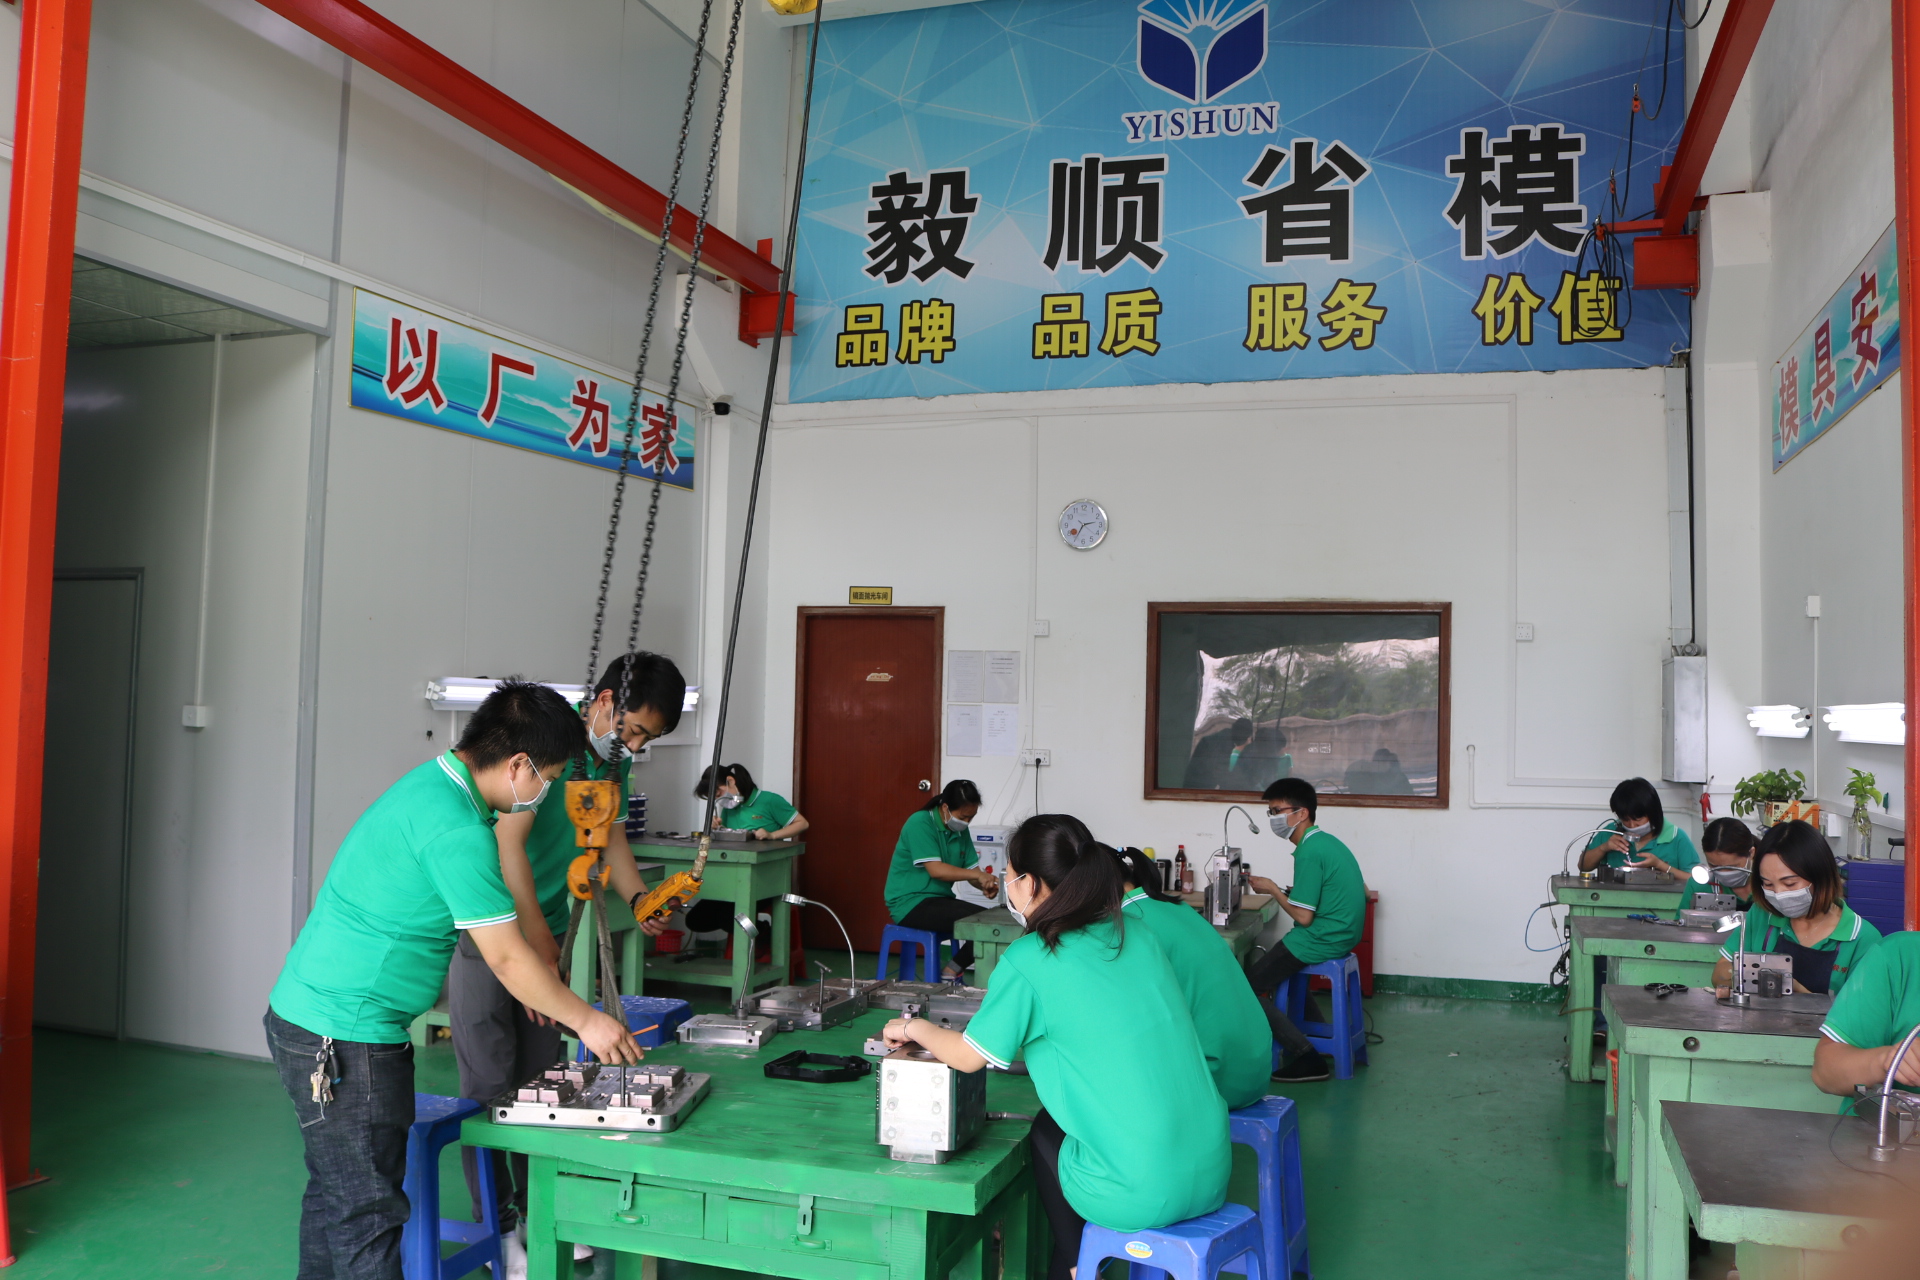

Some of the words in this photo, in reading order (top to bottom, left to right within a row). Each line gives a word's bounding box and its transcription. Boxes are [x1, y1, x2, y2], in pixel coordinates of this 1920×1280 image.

[1125, 105, 1276, 140] YISHUN
[864, 126, 1589, 284] 毅顺省模
[385, 316, 678, 471] 以厂为家
[836, 298, 955, 367] 品牌
[1032, 287, 1162, 359] 品质
[1243, 278, 1387, 351] 服务
[1472, 270, 1624, 345] 价值
[1778, 270, 1879, 451] 模具安
